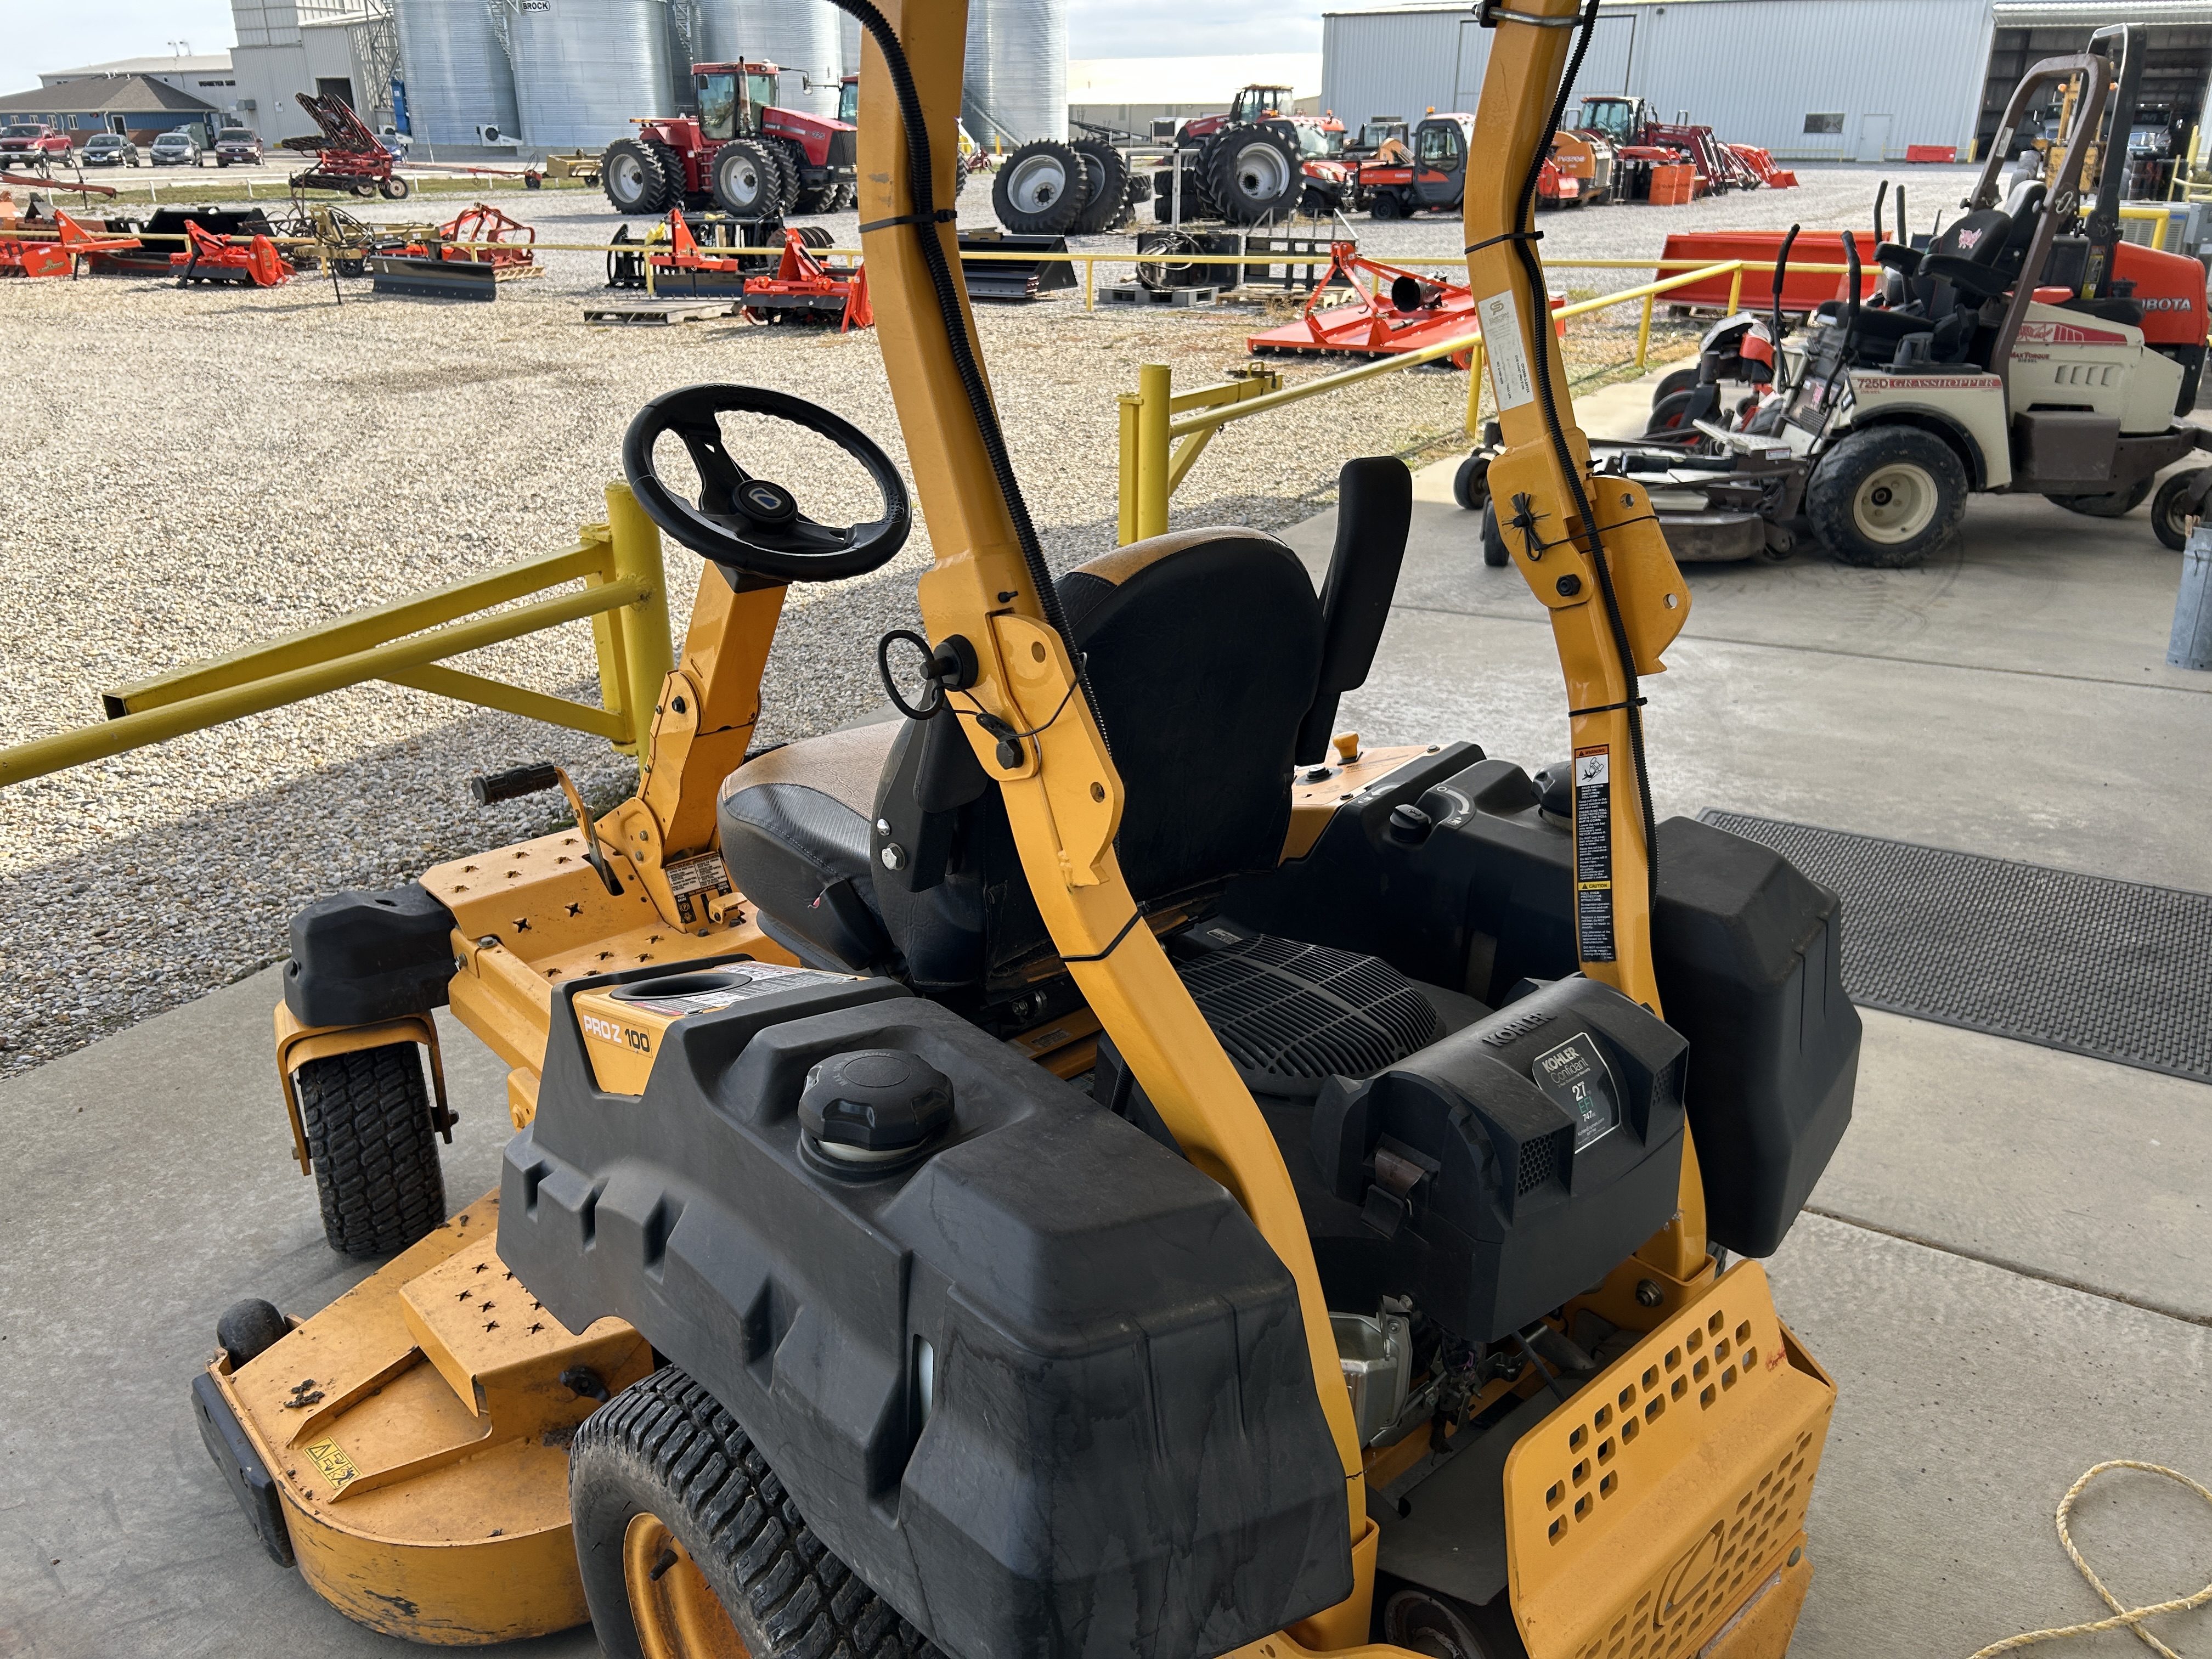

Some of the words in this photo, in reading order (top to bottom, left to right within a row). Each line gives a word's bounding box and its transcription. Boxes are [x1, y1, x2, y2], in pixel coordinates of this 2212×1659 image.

[2142, 298, 2192, 312] BOTA
[1857, 378, 1888, 389] 725D
[1894, 378, 1994, 389] GRASSHOPPER
[624, 1028, 650, 1053] 100
[1482, 1012, 1556, 1047] KOHLER
[832, 1073, 849, 1086] MAX
[844, 1052, 893, 1061] ETHANOL
[1542, 1046, 1580, 1073] KOHLER
[1550, 1057, 1589, 1084] Confidant
[1572, 1081, 1586, 1102] 27
[1578, 1096, 1594, 1114] EFI
[1582, 1110, 1592, 1122] 747
